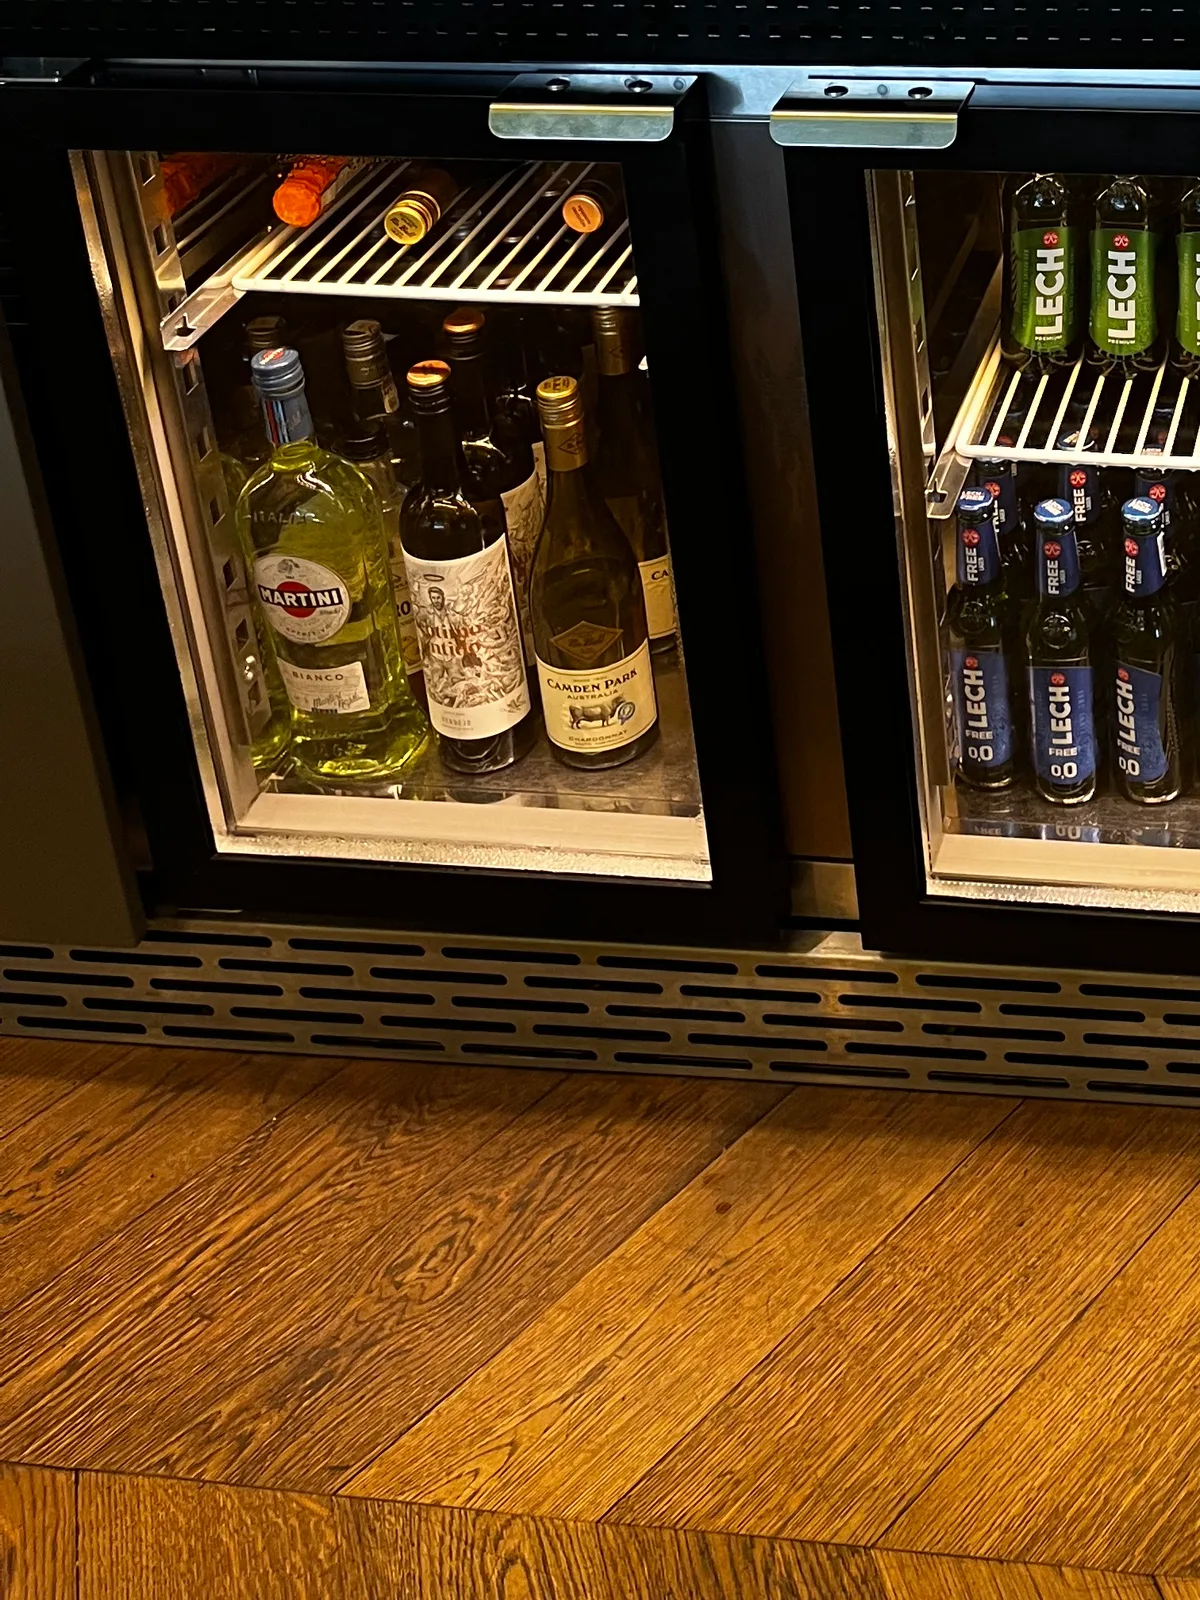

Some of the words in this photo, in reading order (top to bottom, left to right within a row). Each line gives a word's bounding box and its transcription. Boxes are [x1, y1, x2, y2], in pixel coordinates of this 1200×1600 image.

[1035, 247, 1065, 336] LECH
[1107, 250, 1137, 339] LECH
[1073, 488, 1086, 522] FREE
[965, 548, 978, 582] FREE
[1047, 560, 1060, 595] FREE
[1125, 556, 1136, 593] FREE
[260, 586, 339, 607] MARTINI
[291, 671, 344, 681] BIANCO
[547, 678, 600, 693] CAMDEN
[604, 668, 638, 690] PARK
[567, 689, 619, 700] AUSTRALIA
[963, 669, 989, 728] LECH
[1048, 686, 1073, 745] LECH
[1116, 678, 1137, 747] LECH
[568, 729, 628, 742] CHARDONNAY
[965, 730, 993, 740] FREE
[1048, 747, 1078, 757] FREE
[1117, 738, 1141, 756] FREE
